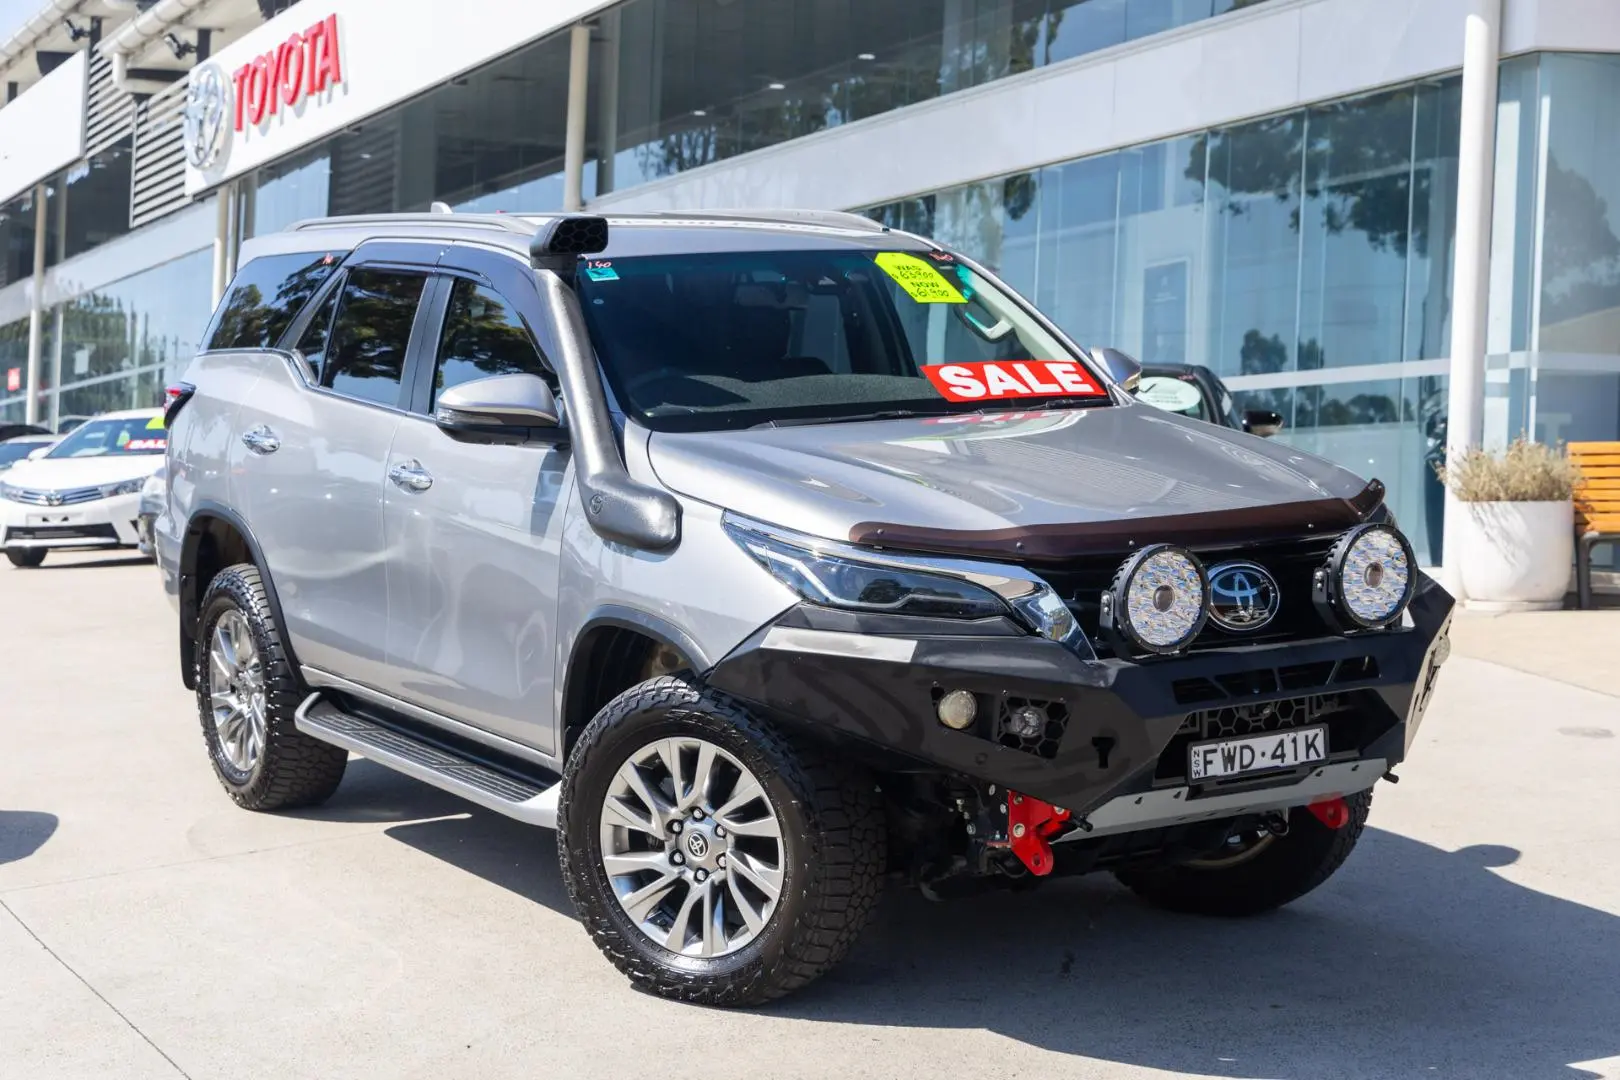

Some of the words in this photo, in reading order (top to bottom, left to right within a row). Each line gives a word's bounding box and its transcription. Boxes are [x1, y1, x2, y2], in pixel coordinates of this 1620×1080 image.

[233, 13, 341, 132] TOYOTA
[938, 363, 1095, 398] SALE
[1192, 749, 1201, 778] NSW
